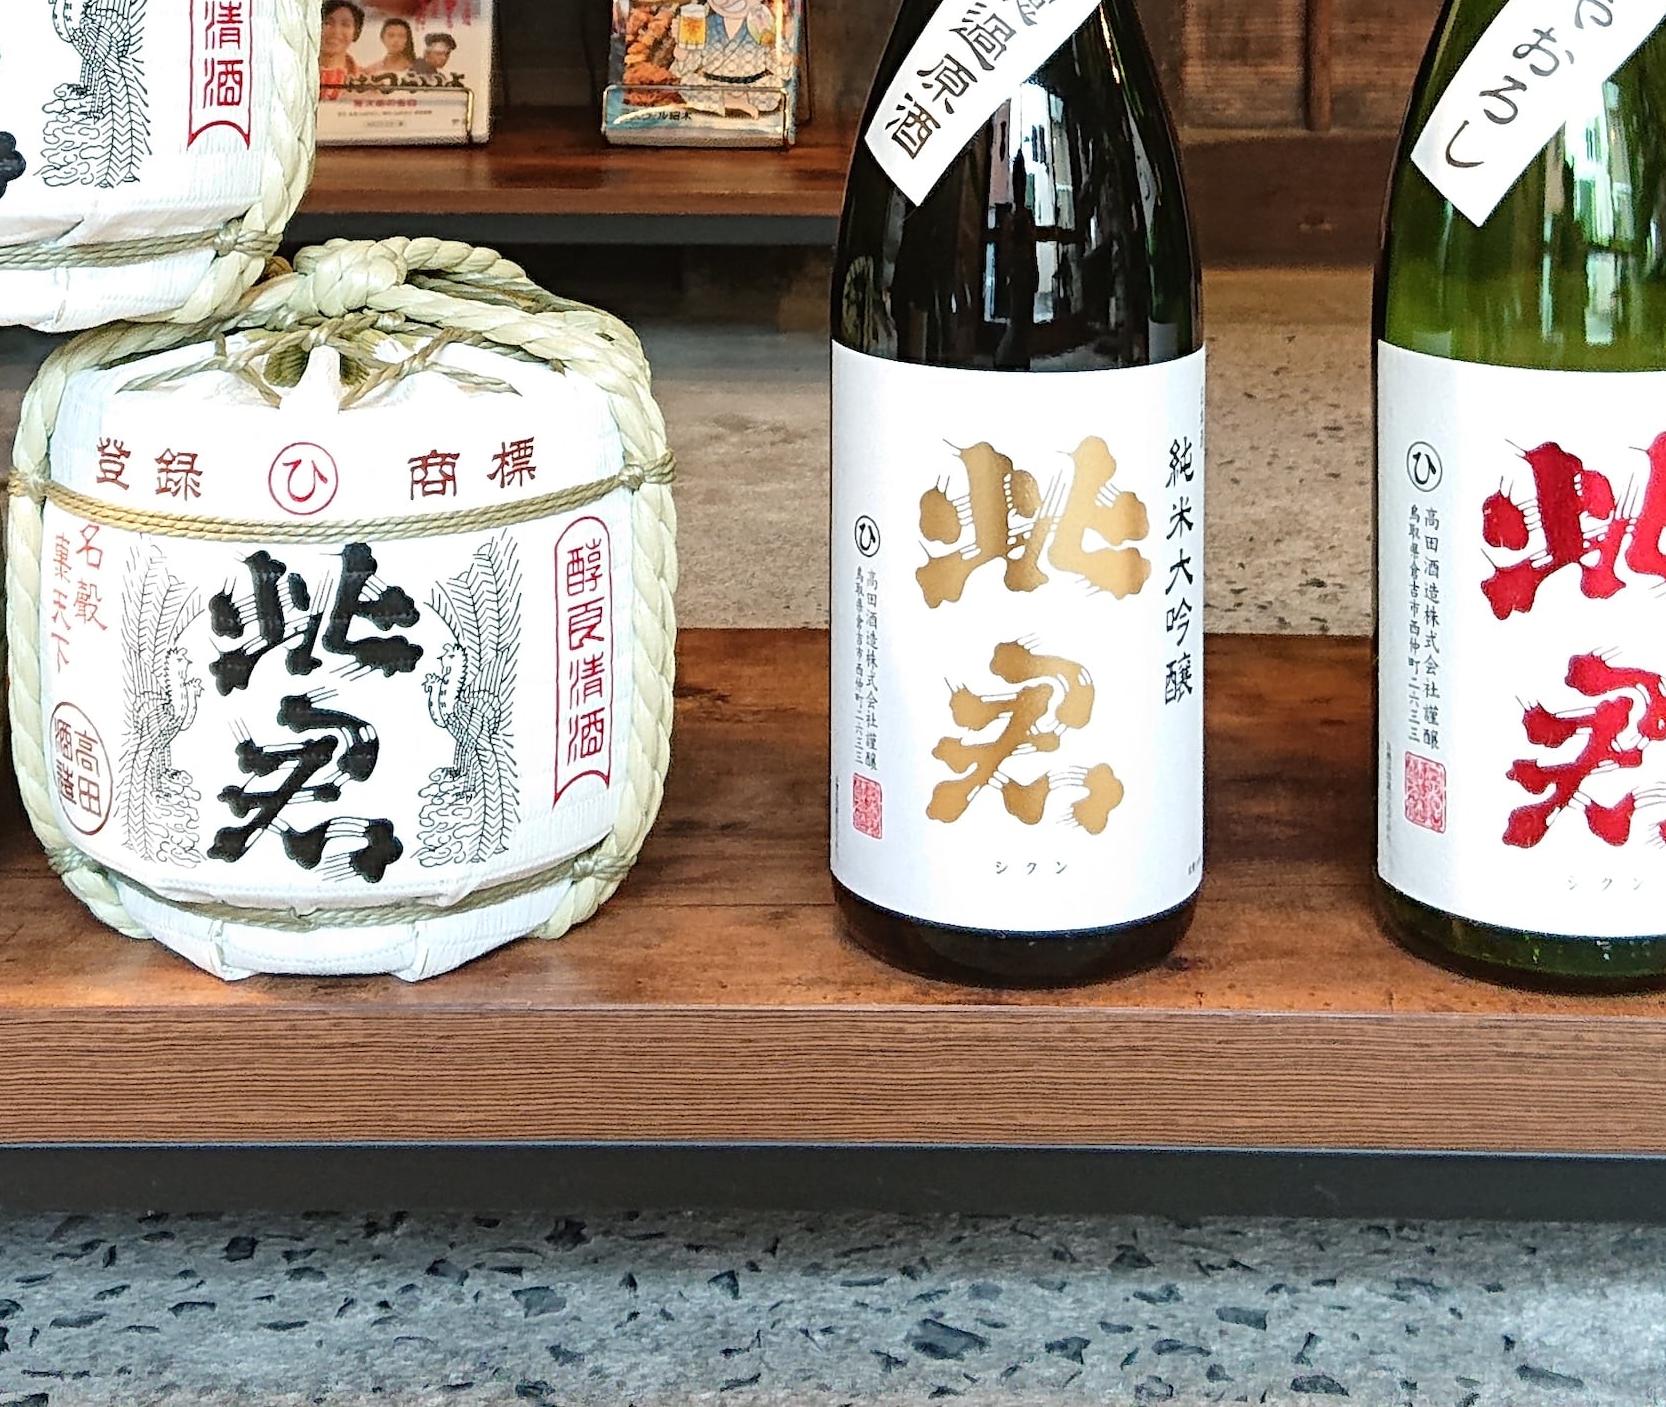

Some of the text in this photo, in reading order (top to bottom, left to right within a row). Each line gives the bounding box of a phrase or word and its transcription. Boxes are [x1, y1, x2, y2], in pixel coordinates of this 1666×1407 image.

[94, 437, 204, 500] 登録
[408, 436, 537, 501] 商標
[1164, 435, 1195, 706] 純米大吟醸
[206, 540, 425, 883] 此君
[915, 435, 1152, 836] 此君
[995, 860, 1069, 876] シクン
